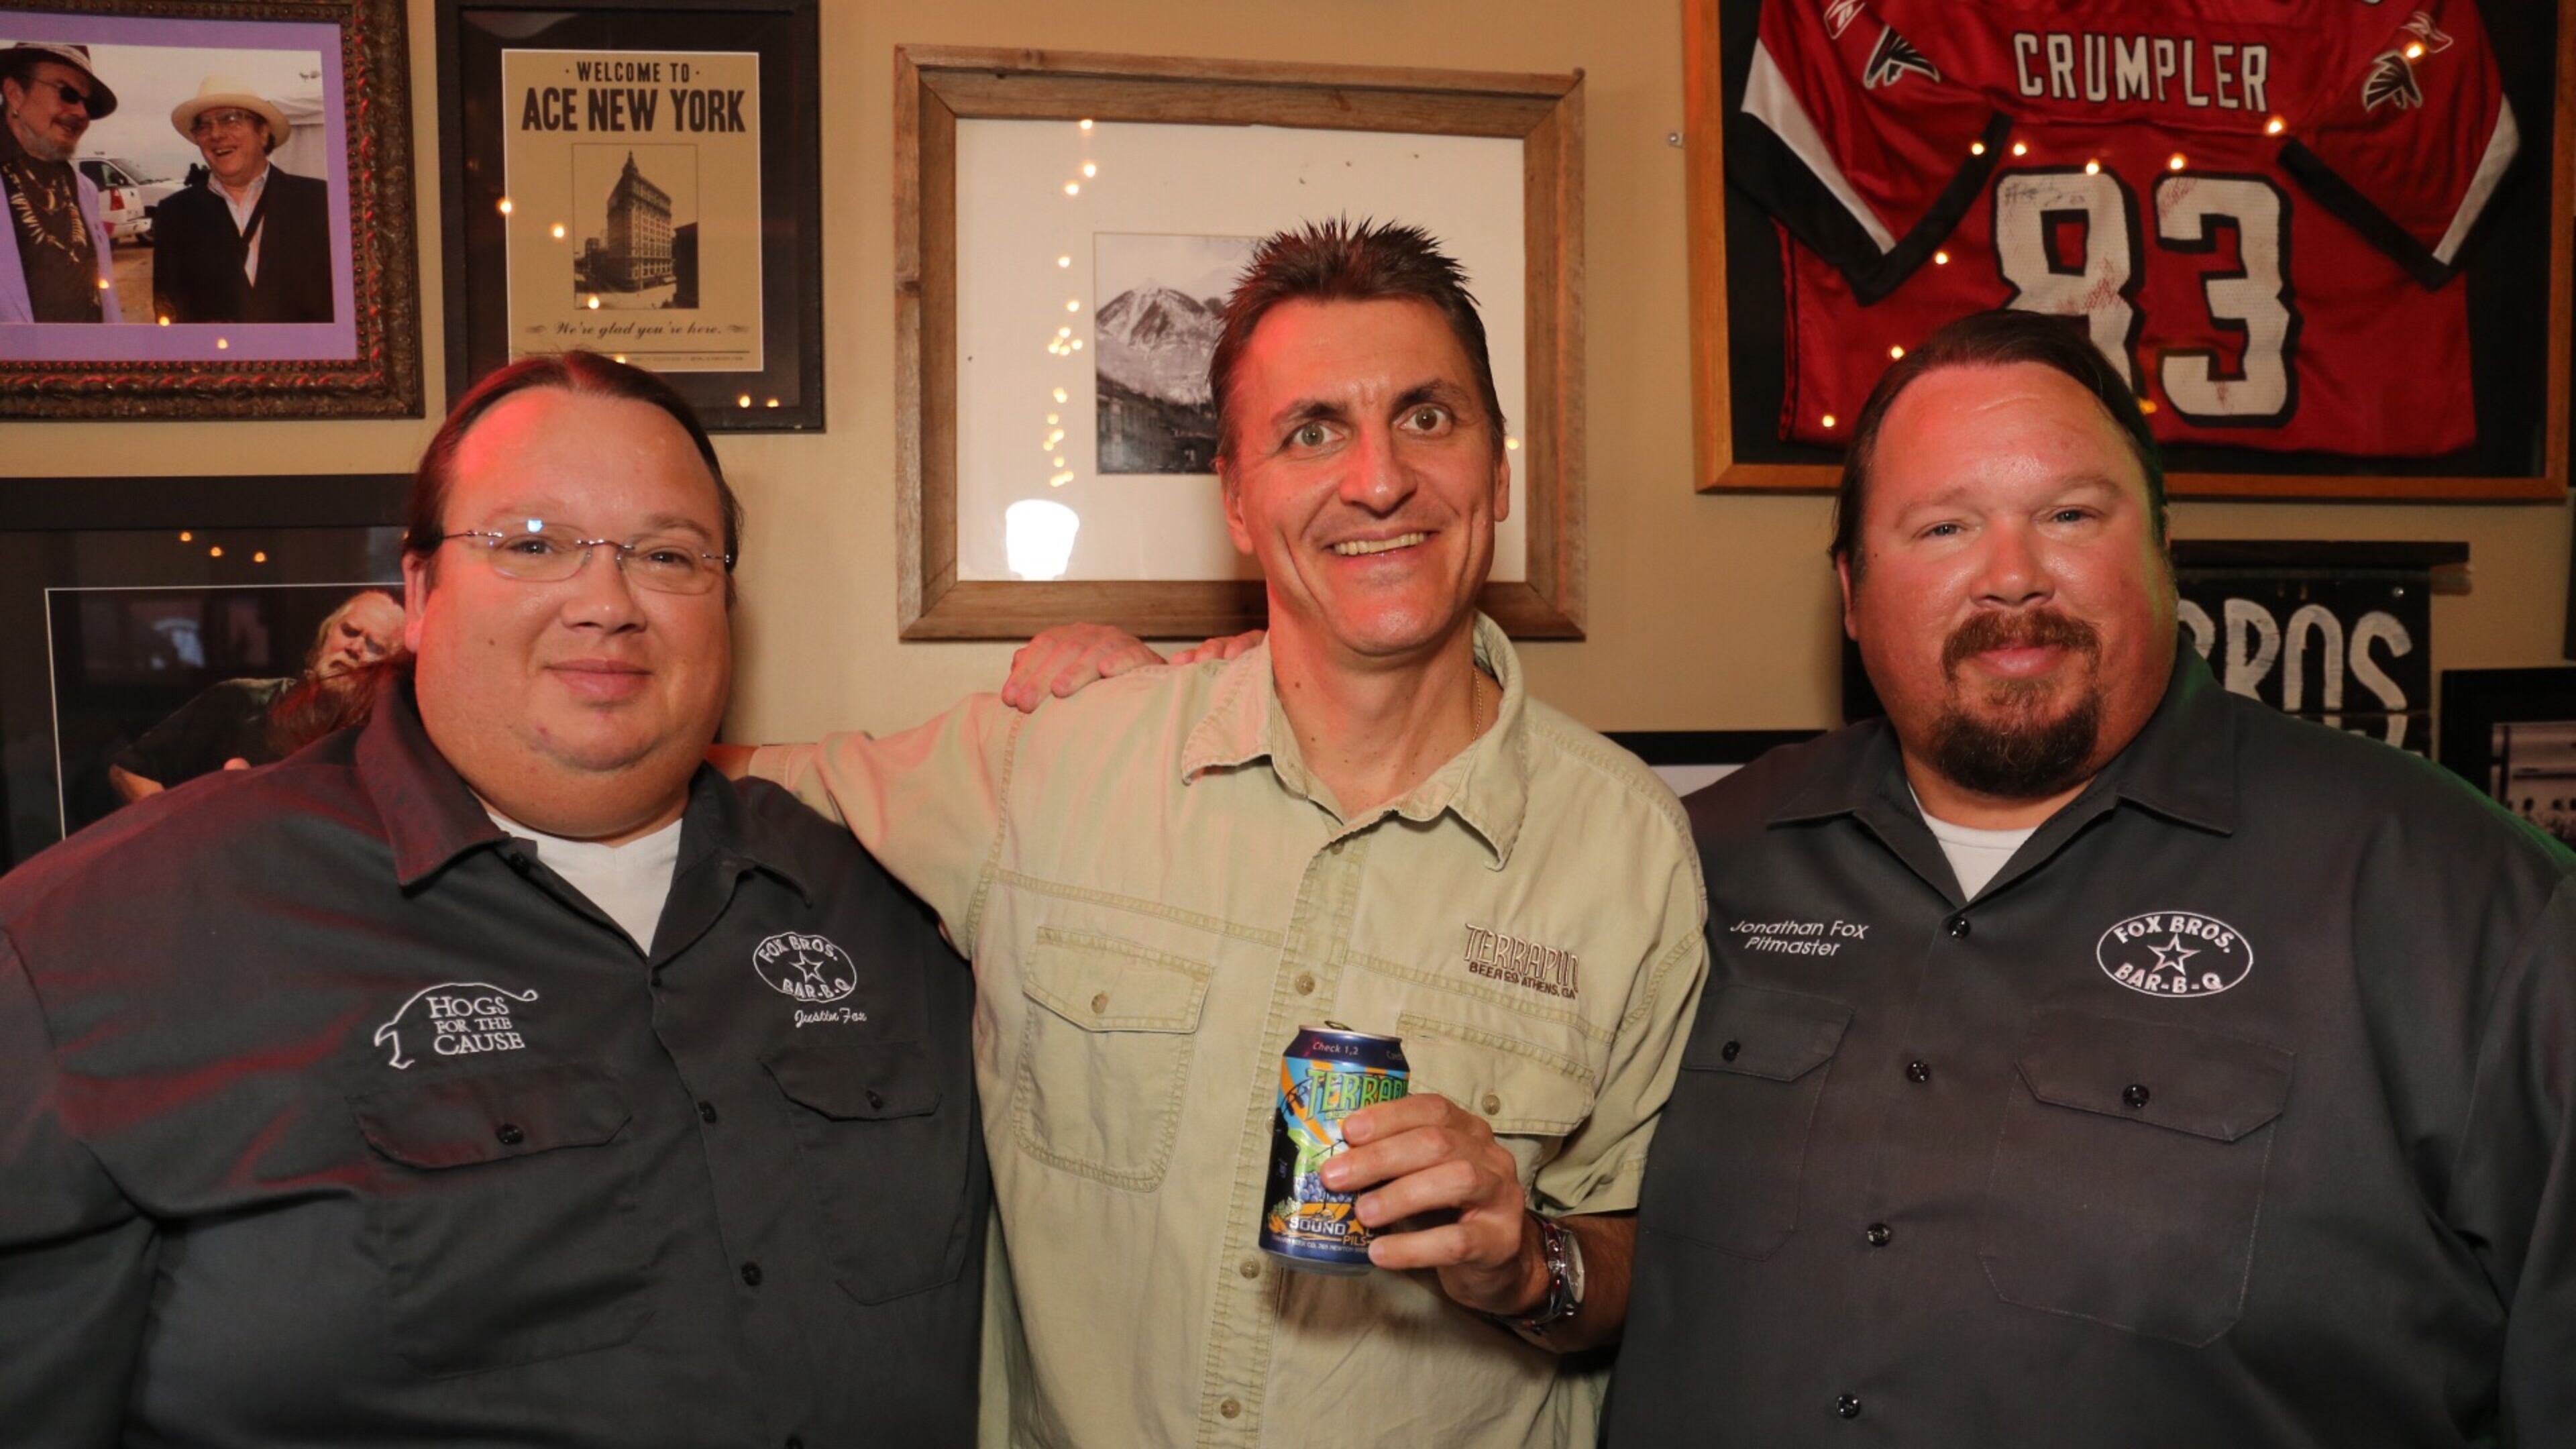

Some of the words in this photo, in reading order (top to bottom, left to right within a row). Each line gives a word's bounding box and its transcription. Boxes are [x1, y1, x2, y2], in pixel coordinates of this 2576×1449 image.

[576, 61, 661, 83] WELCOME
[669, 62, 690, 83] TO
[2013, 32, 2268, 113] CRUMPLER
[521, 87, 578, 131] ACE
[588, 88, 658, 132] NEW
[669, 89, 746, 133] YORK
[1993, 169, 2296, 421] 83
[555, 321, 595, 335] We're
[597, 321, 636, 339] glad
[636, 321, 684, 340] you're
[688, 321, 722, 335] here.
[1729, 920, 1825, 936] Jonathan
[1829, 920, 1870, 940] Fox
[2113, 915, 2163, 945] FOX
[2168, 915, 2235, 954] BROS.
[758, 938, 790, 964] FOX
[788, 936, 838, 961] BROS.
[1744, 936, 1841, 957] Pitmaster
[1468, 961, 1503, 981] BEER
[1561, 988, 1576, 1000] GA
[2113, 962, 2224, 994] BAR-B-Q
[425, 996, 511, 1019] HOGS
[839, 1007, 867, 1024] Fox
[434, 1020, 472, 1034] FOR
[474, 1016, 513, 1032] THE
[433, 1031, 526, 1056] CAUSE
[1312, 1040, 1341, 1055] Check
[1289, 1216, 1346, 1236] SOUND
[1342, 1234, 1371, 1247] PILS
